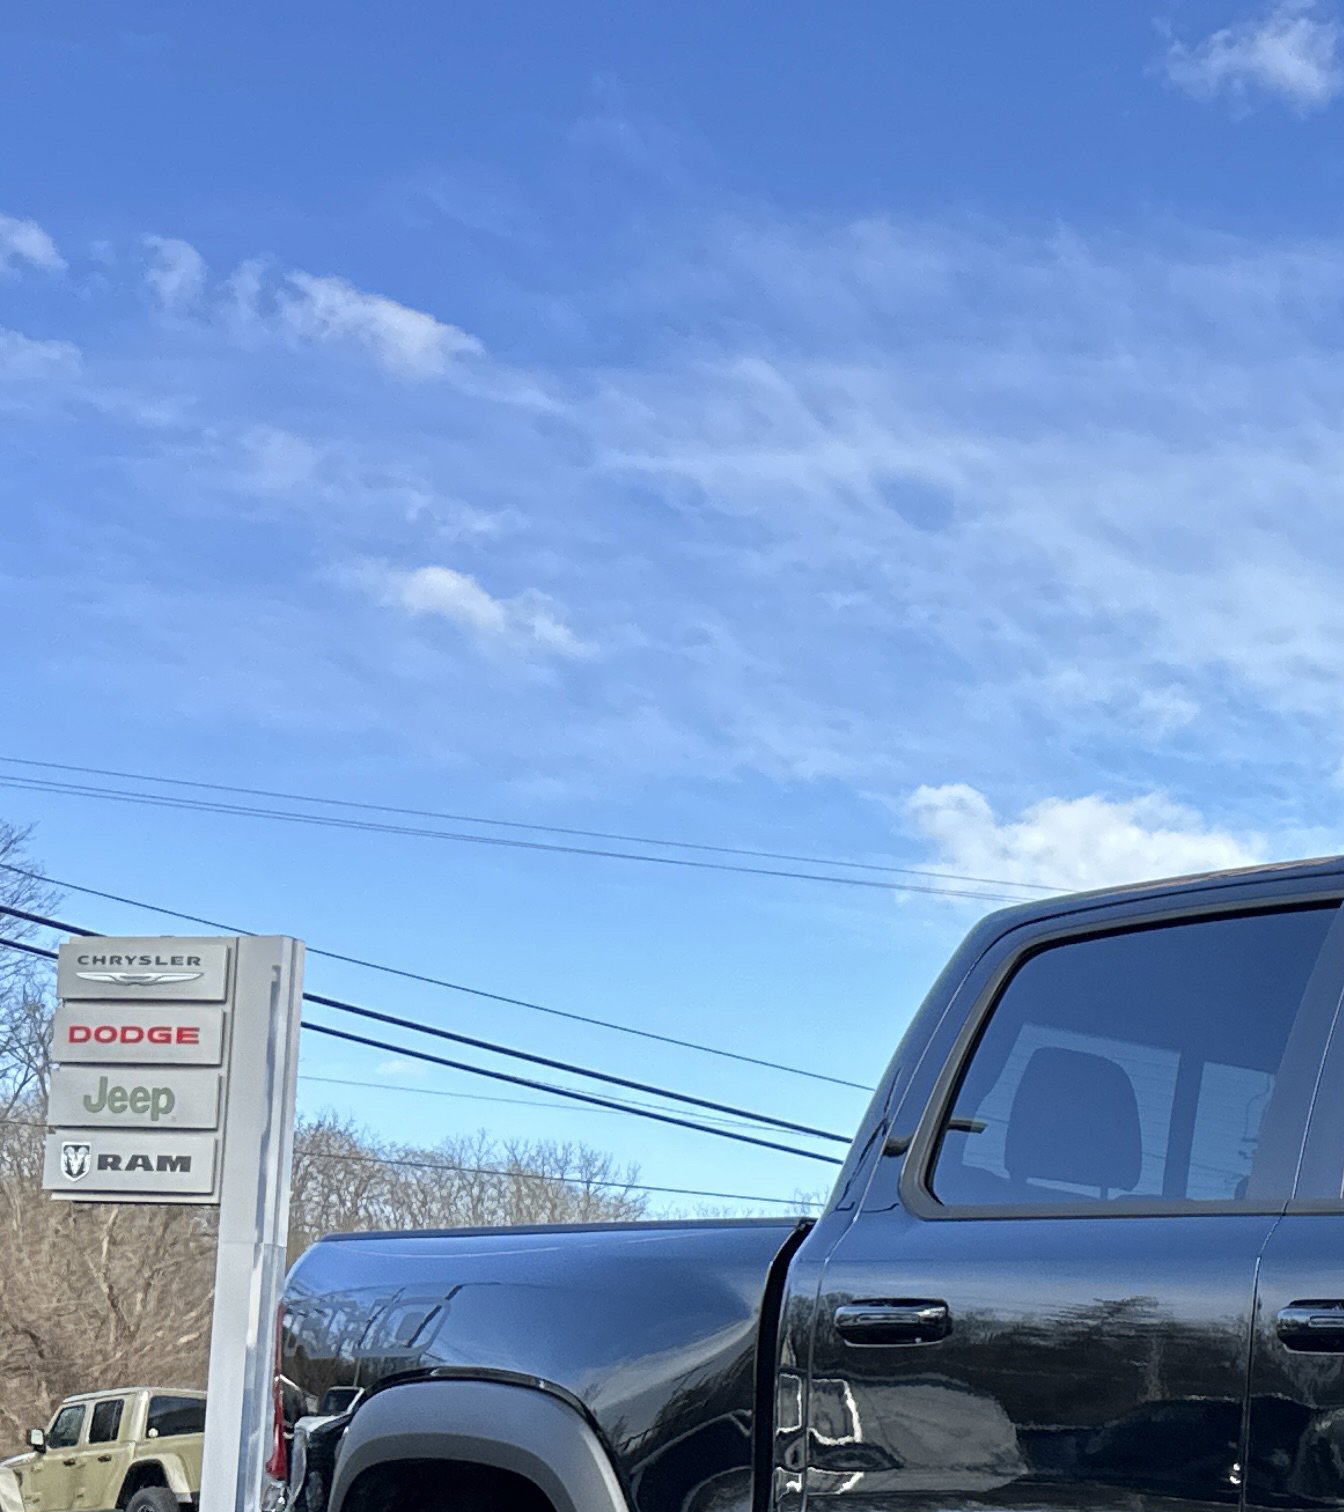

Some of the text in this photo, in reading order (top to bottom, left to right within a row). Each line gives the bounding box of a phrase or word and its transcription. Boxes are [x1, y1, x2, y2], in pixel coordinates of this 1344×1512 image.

[76, 955, 202, 967] CHRYSLER
[68, 1025, 200, 1045] DODGE
[83, 1076, 176, 1122] Jeep
[96, 1153, 192, 1173] RAM
